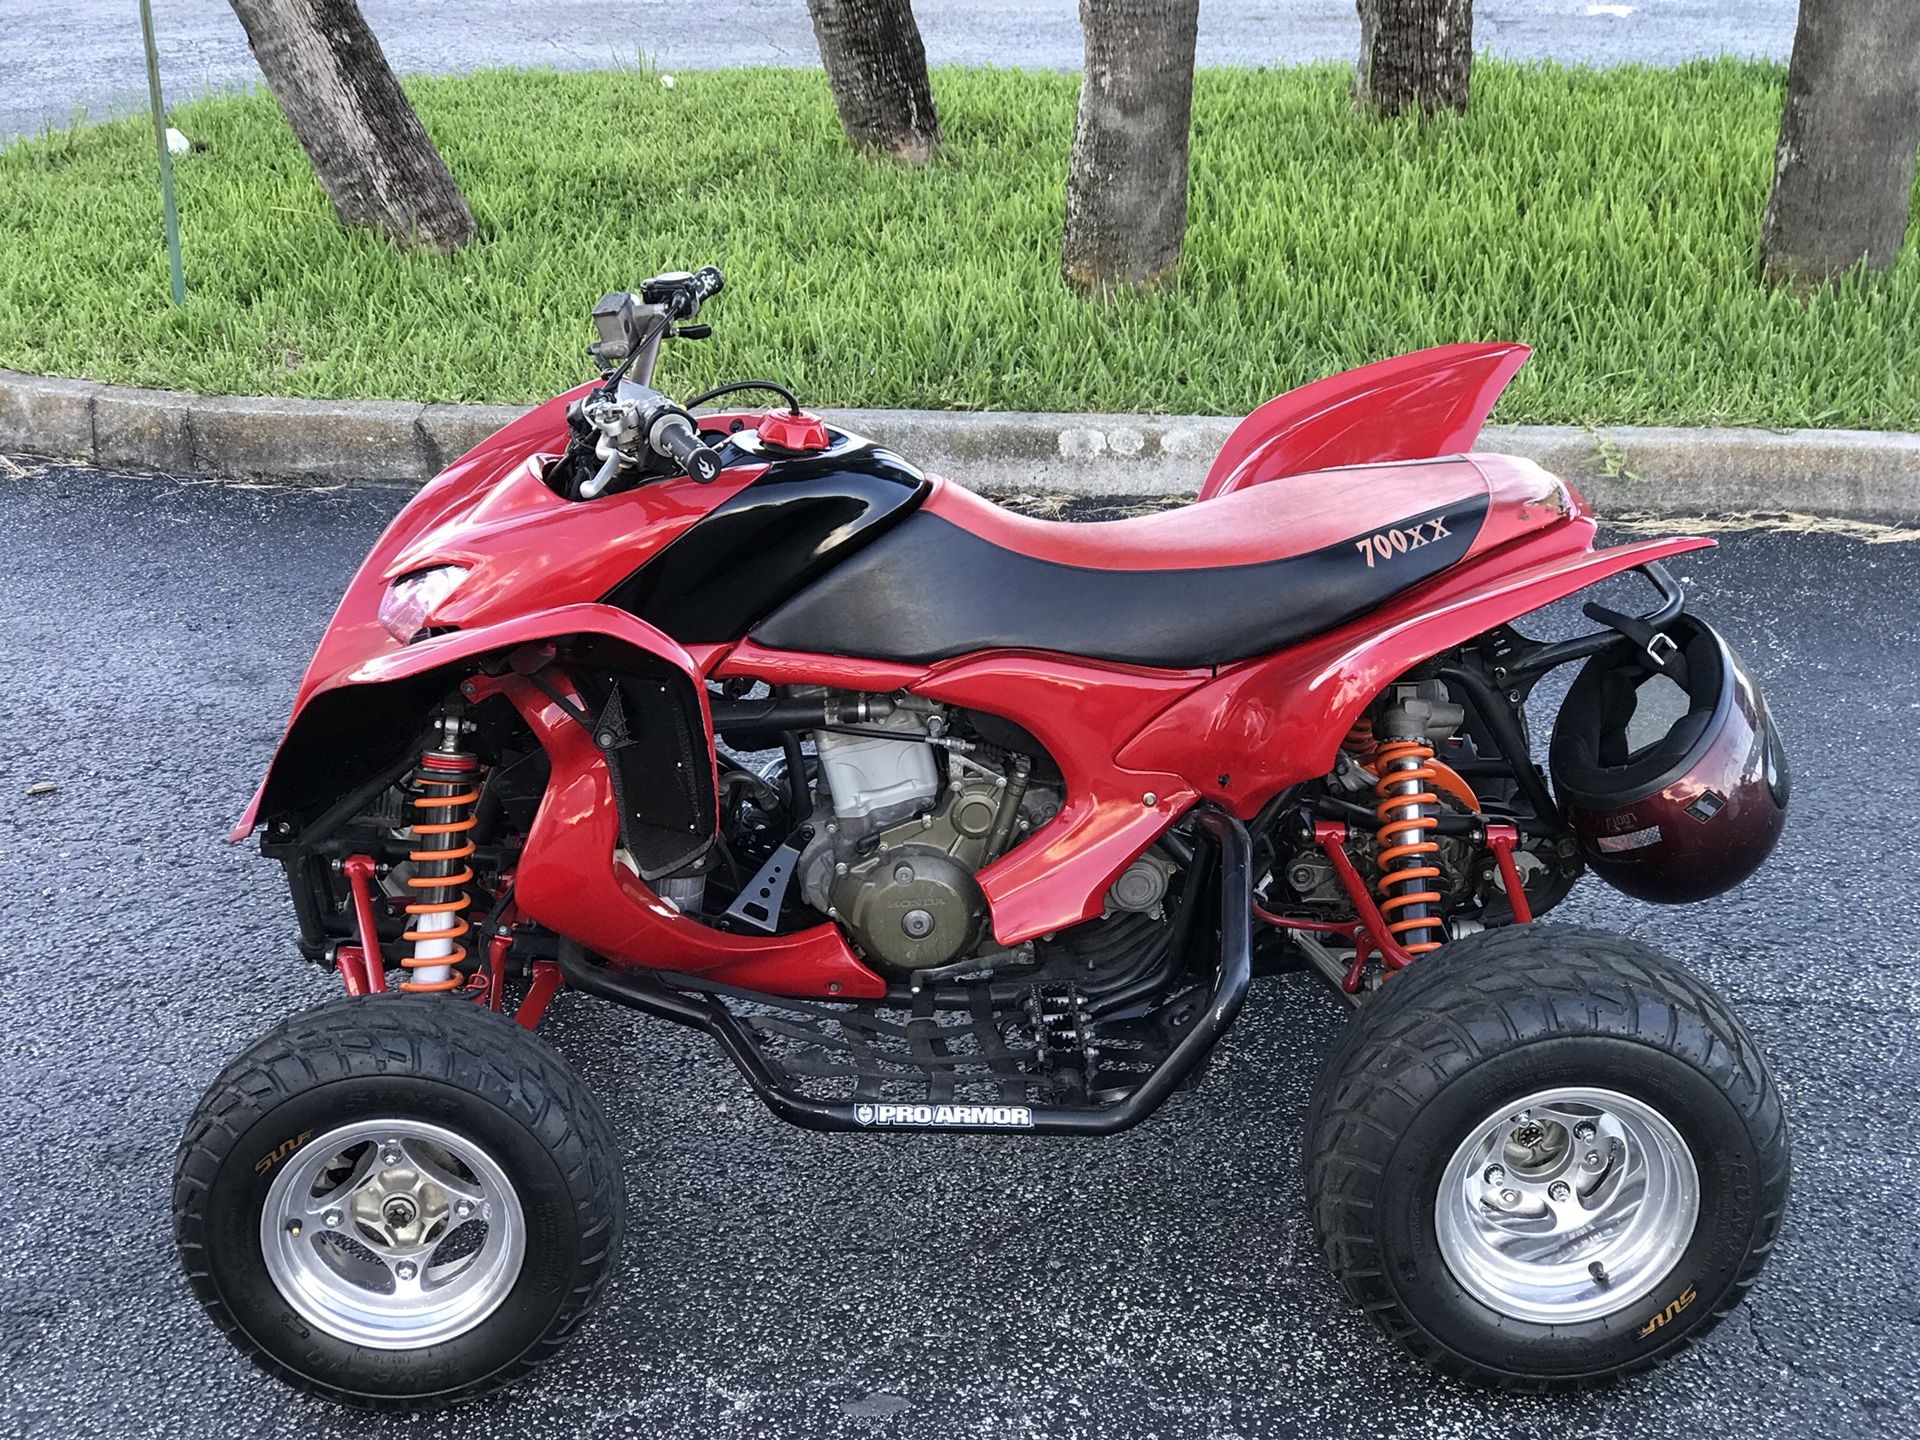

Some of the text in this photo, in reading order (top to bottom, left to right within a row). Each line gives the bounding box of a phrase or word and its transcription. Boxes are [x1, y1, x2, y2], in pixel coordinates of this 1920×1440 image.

[1355, 515, 1453, 568] 700XX
[887, 898, 947, 908] HONDA
[878, 1106, 1029, 1125] PRO ARMOR
